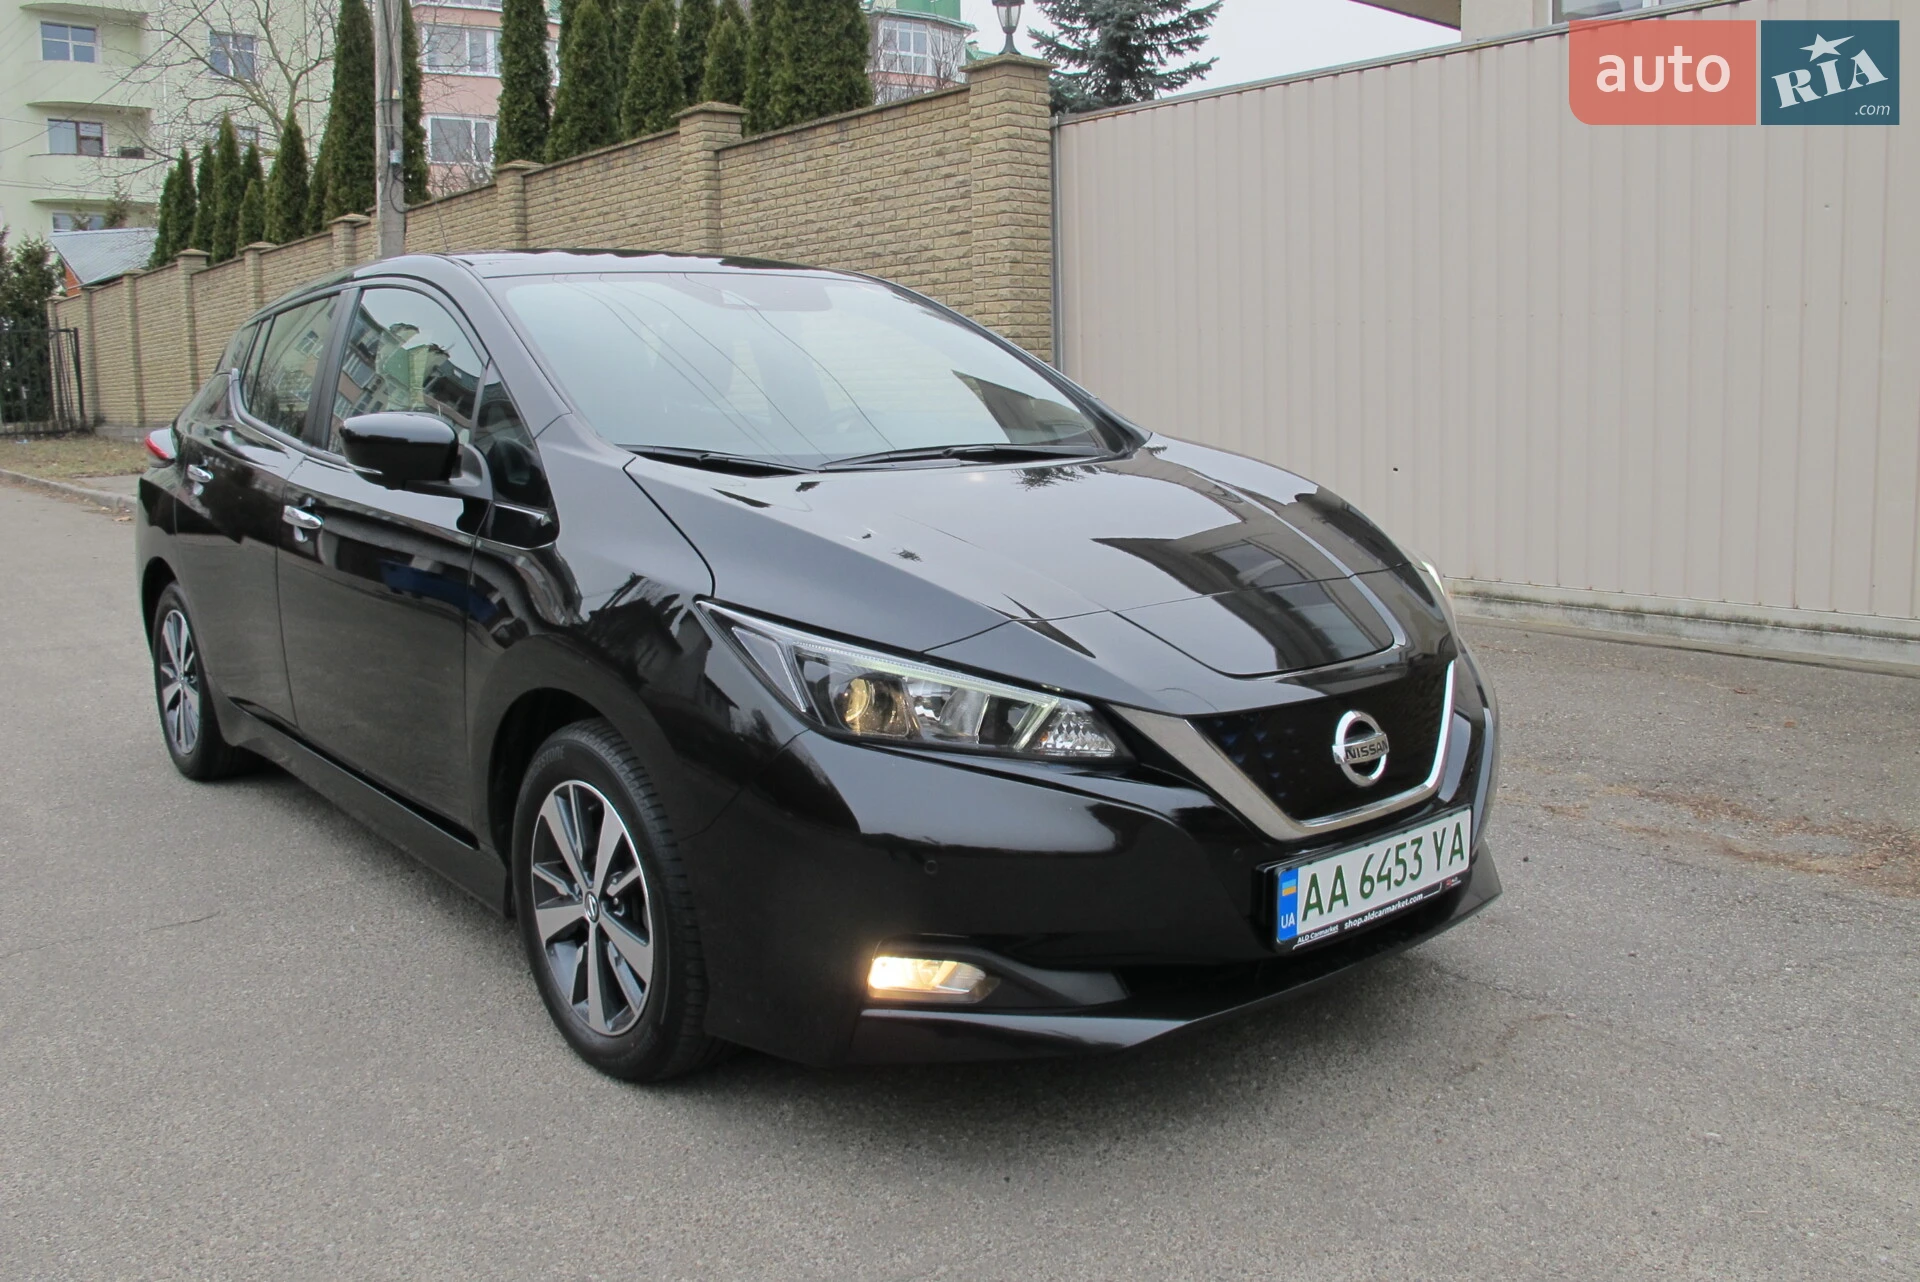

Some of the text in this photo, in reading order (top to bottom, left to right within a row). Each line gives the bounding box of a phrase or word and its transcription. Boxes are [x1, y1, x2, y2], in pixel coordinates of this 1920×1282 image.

[1345, 740, 1389, 760] NISSAN
[1301, 822, 1465, 922] AA 6453 YA
[1281, 914, 1296, 929] UA
[1344, 893, 1424, 930] shop.aldcarmarket.com
[1310, 924, 1339, 939] Carmarket
